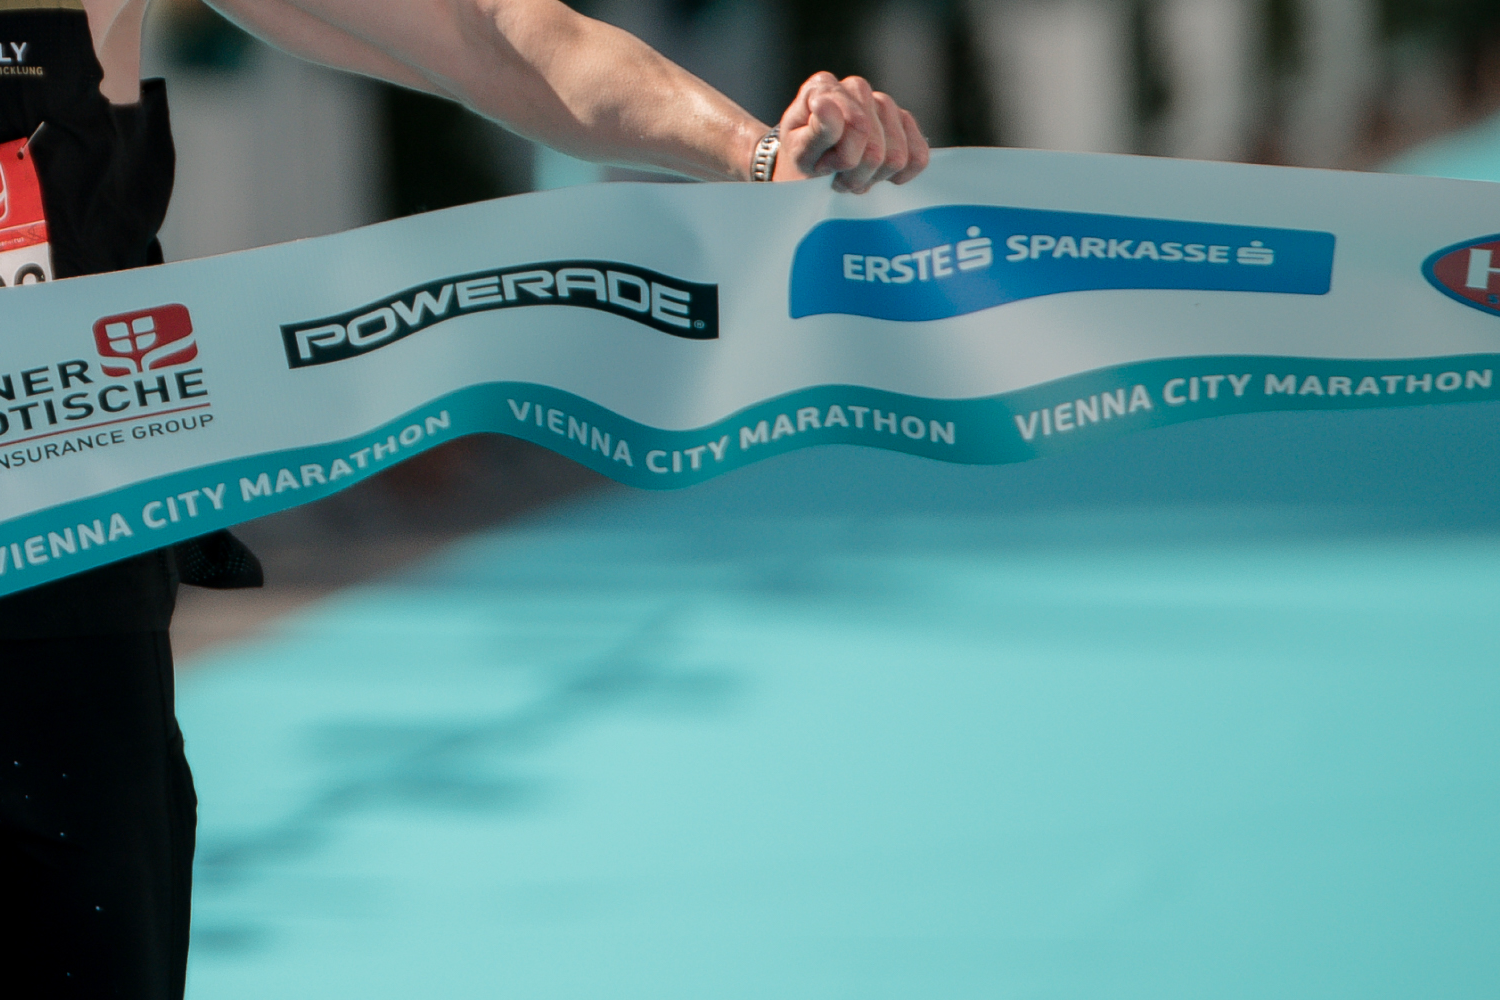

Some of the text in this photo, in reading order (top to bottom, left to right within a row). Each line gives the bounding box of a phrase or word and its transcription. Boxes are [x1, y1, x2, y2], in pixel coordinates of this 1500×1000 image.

[842, 234, 1231, 284] ERSTE SPARKASSE
[294, 267, 691, 359] POWERADE
[131, 413, 215, 440] GROUP
[507, 397, 956, 475] VIENNA CITY MARATHON
[1013, 367, 1494, 442] VIENNA CITY MARATHON
[141, 482, 227, 530] CITY
[239, 409, 452, 502] MARATHON
